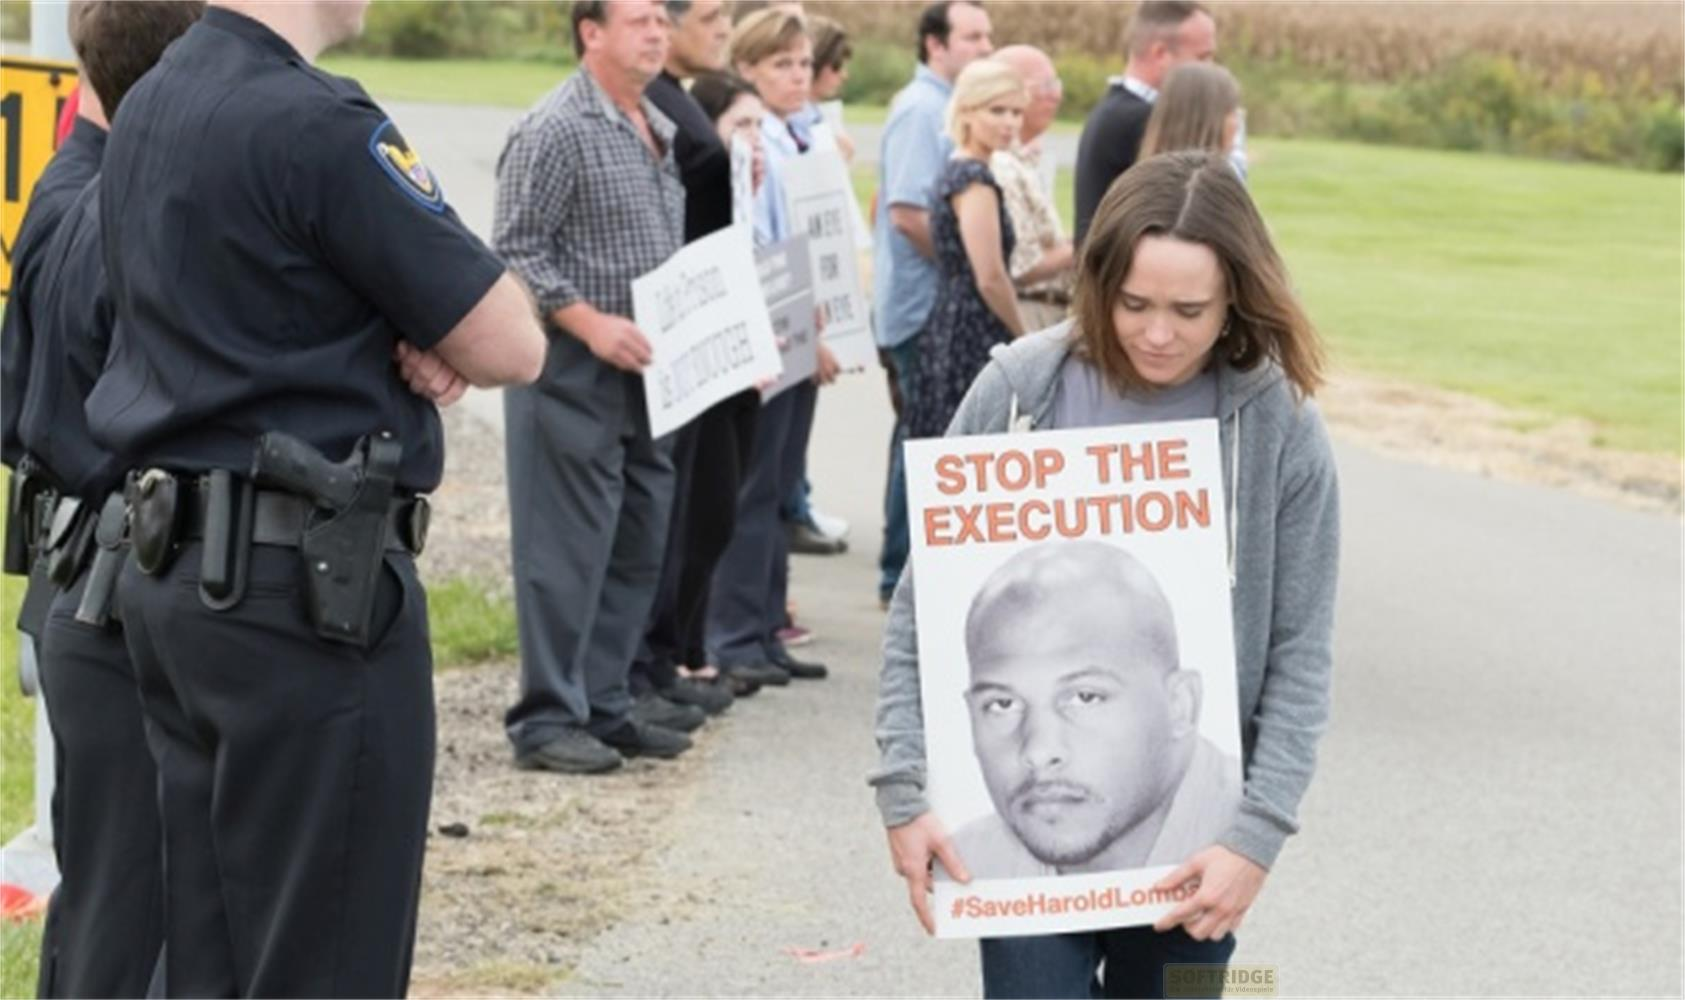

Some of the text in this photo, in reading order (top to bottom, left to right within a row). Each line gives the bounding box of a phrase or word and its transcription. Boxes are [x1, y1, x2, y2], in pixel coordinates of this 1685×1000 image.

[935, 439, 1191, 495] STOP THE
[923, 488, 1211, 547] EXECUTION
